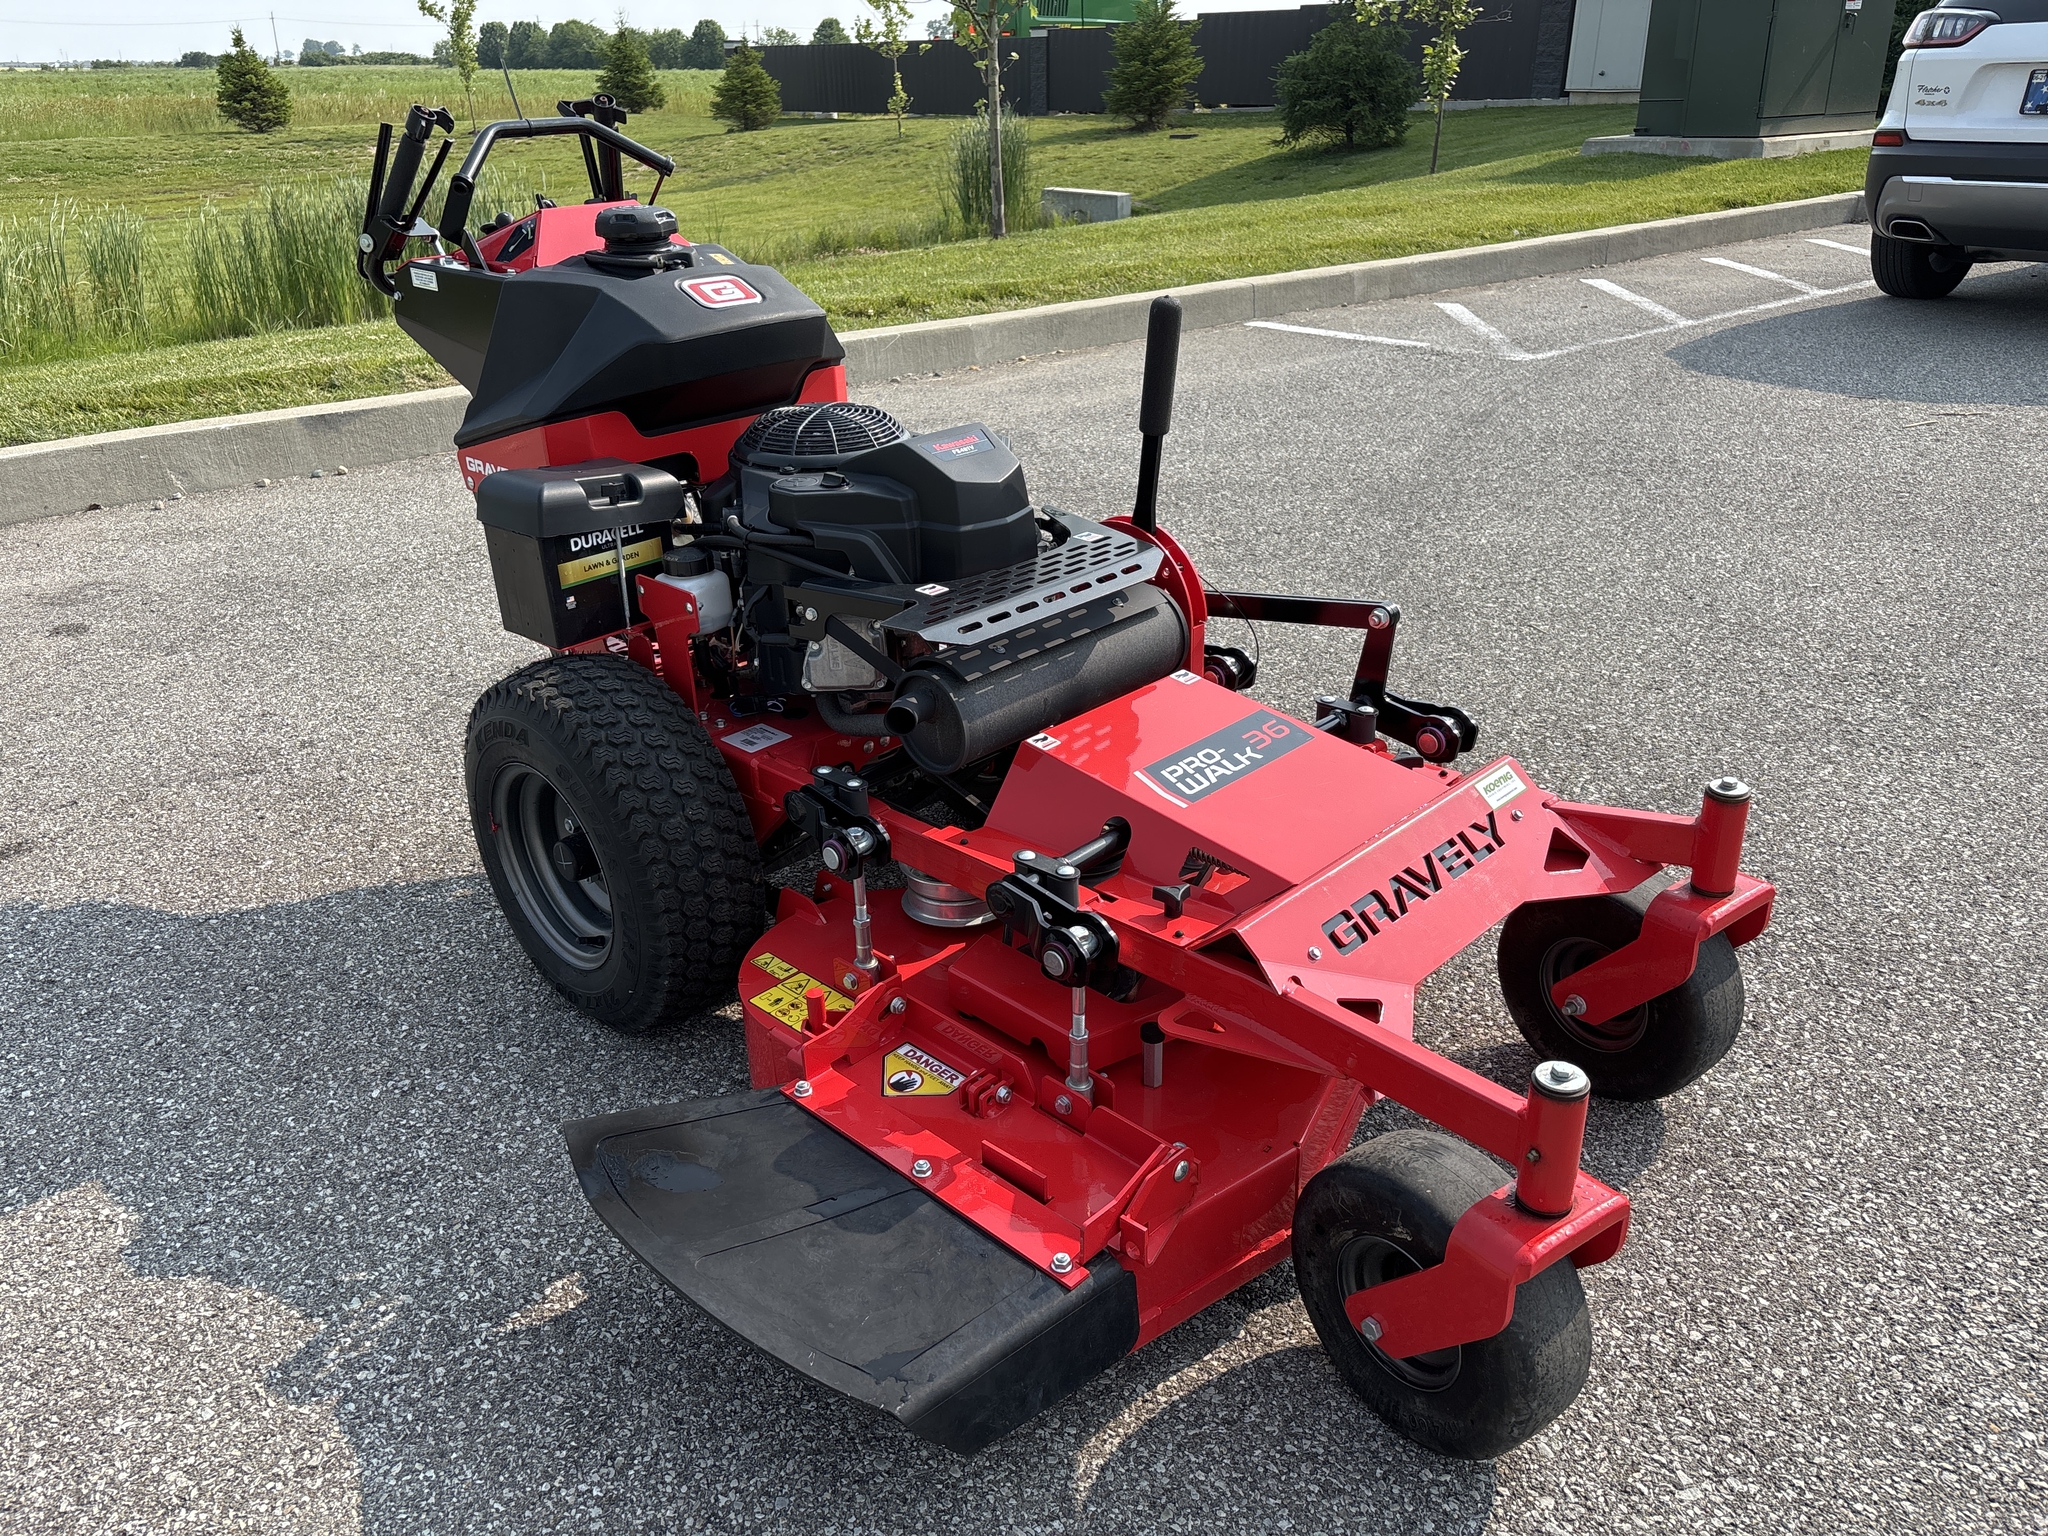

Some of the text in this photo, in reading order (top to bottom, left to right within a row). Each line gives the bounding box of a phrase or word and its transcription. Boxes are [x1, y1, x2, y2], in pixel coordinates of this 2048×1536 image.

[699, 281, 747, 301] G
[932, 434, 980, 451] Kawasaki
[465, 456, 509, 476] GRAV
[583, 560, 605, 573] LAWN
[611, 550, 640, 564] GRDEN
[475, 719, 531, 754] KENDA
[1241, 718, 1291, 750] 36
[1160, 747, 1226, 784] PRO-
[1175, 746, 1264, 795] WALK
[1321, 810, 1506, 957] GRAVELY
[893, 1053, 906, 1062] KEEP
[904, 1060, 919, 1071] HANDS
[926, 1073, 939, 1082] FEET
[937, 1079, 952, 1090] AWAY
[903, 1048, 960, 1084] DANGER
